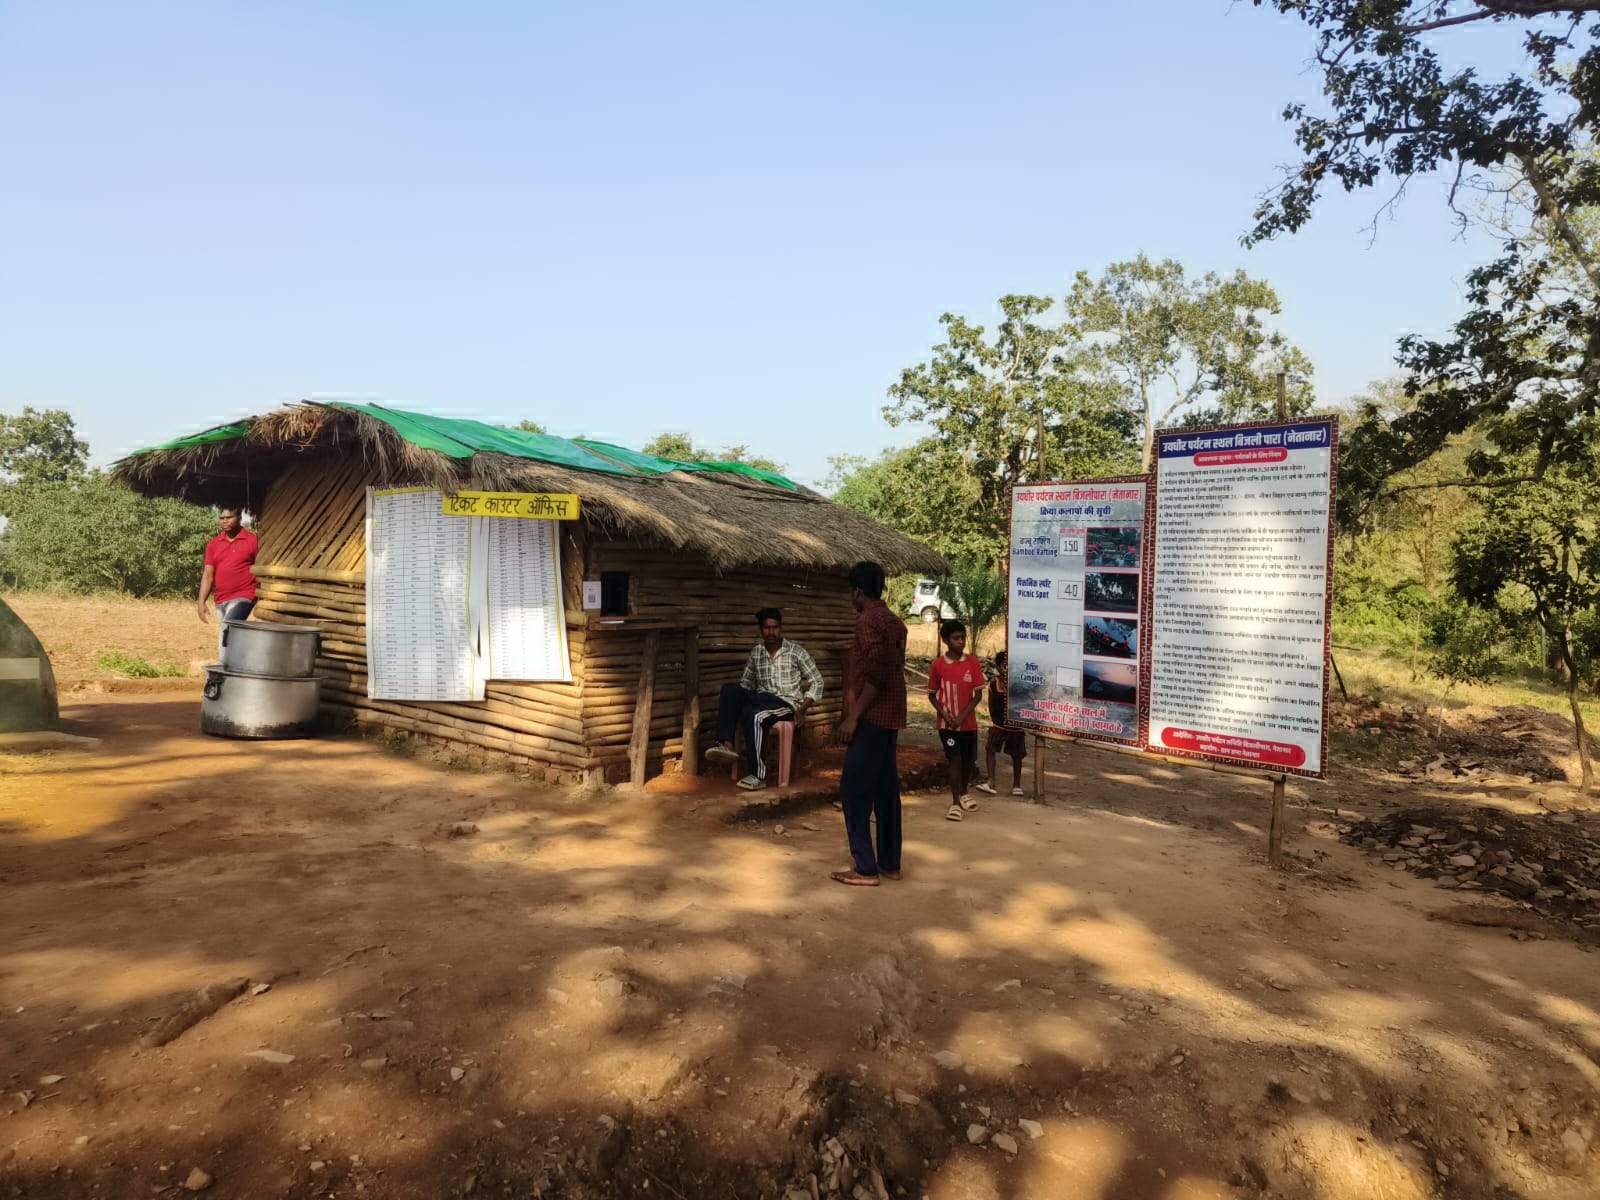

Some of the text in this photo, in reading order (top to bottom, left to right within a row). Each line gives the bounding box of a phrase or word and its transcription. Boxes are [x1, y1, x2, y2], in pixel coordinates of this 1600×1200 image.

[1212, 437, 1233, 449] स्थल
[1235, 433, 1262, 448] बिजली
[1264, 432, 1281, 445] पारा
[449, 493, 569, 517] टिकट काउंटर ऑफिस
[1084, 505, 1094, 515] की
[1096, 506, 1111, 517] सूची
[1063, 540, 1078, 552] 150
[1036, 548, 1058, 557] Rafting
[1017, 589, 1049, 599] Picnic Spot
[1064, 584, 1078, 597] 40
[1016, 630, 1030, 640] Boat
